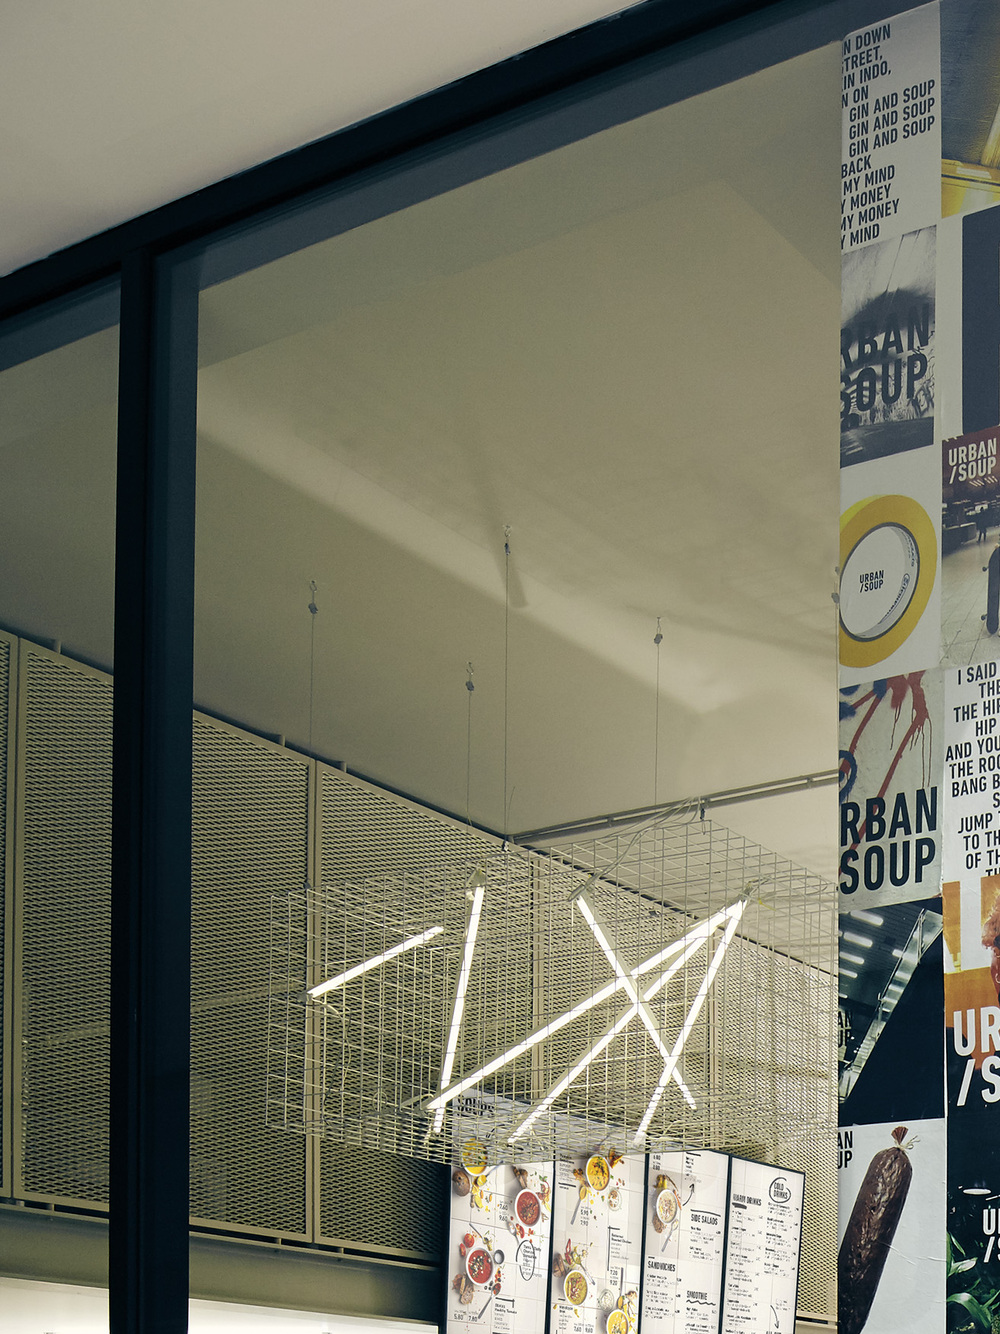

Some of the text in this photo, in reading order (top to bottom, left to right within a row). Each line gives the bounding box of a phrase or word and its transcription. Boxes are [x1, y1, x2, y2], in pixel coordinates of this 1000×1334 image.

[860, 60, 892, 84] INDO,
[850, 79, 935, 122] GIN AND SOUP
[849, 115, 935, 157] GIN AND SOUP
[841, 155, 872, 179] BACK
[843, 164, 895, 196] MY MIND
[949, 438, 997, 466] URBAN
[950, 456, 997, 484] /SOUP
[860, 570, 884, 583] URBAN
[860, 580, 884, 593] /SOUP
[958, 670, 962, 685] I
[967, 662, 997, 683] SAID
[945, 743, 972, 762] AND
[951, 776, 987, 798] BANG
[963, 835, 981, 851] TO
[840, 838, 935, 894] SOUP
